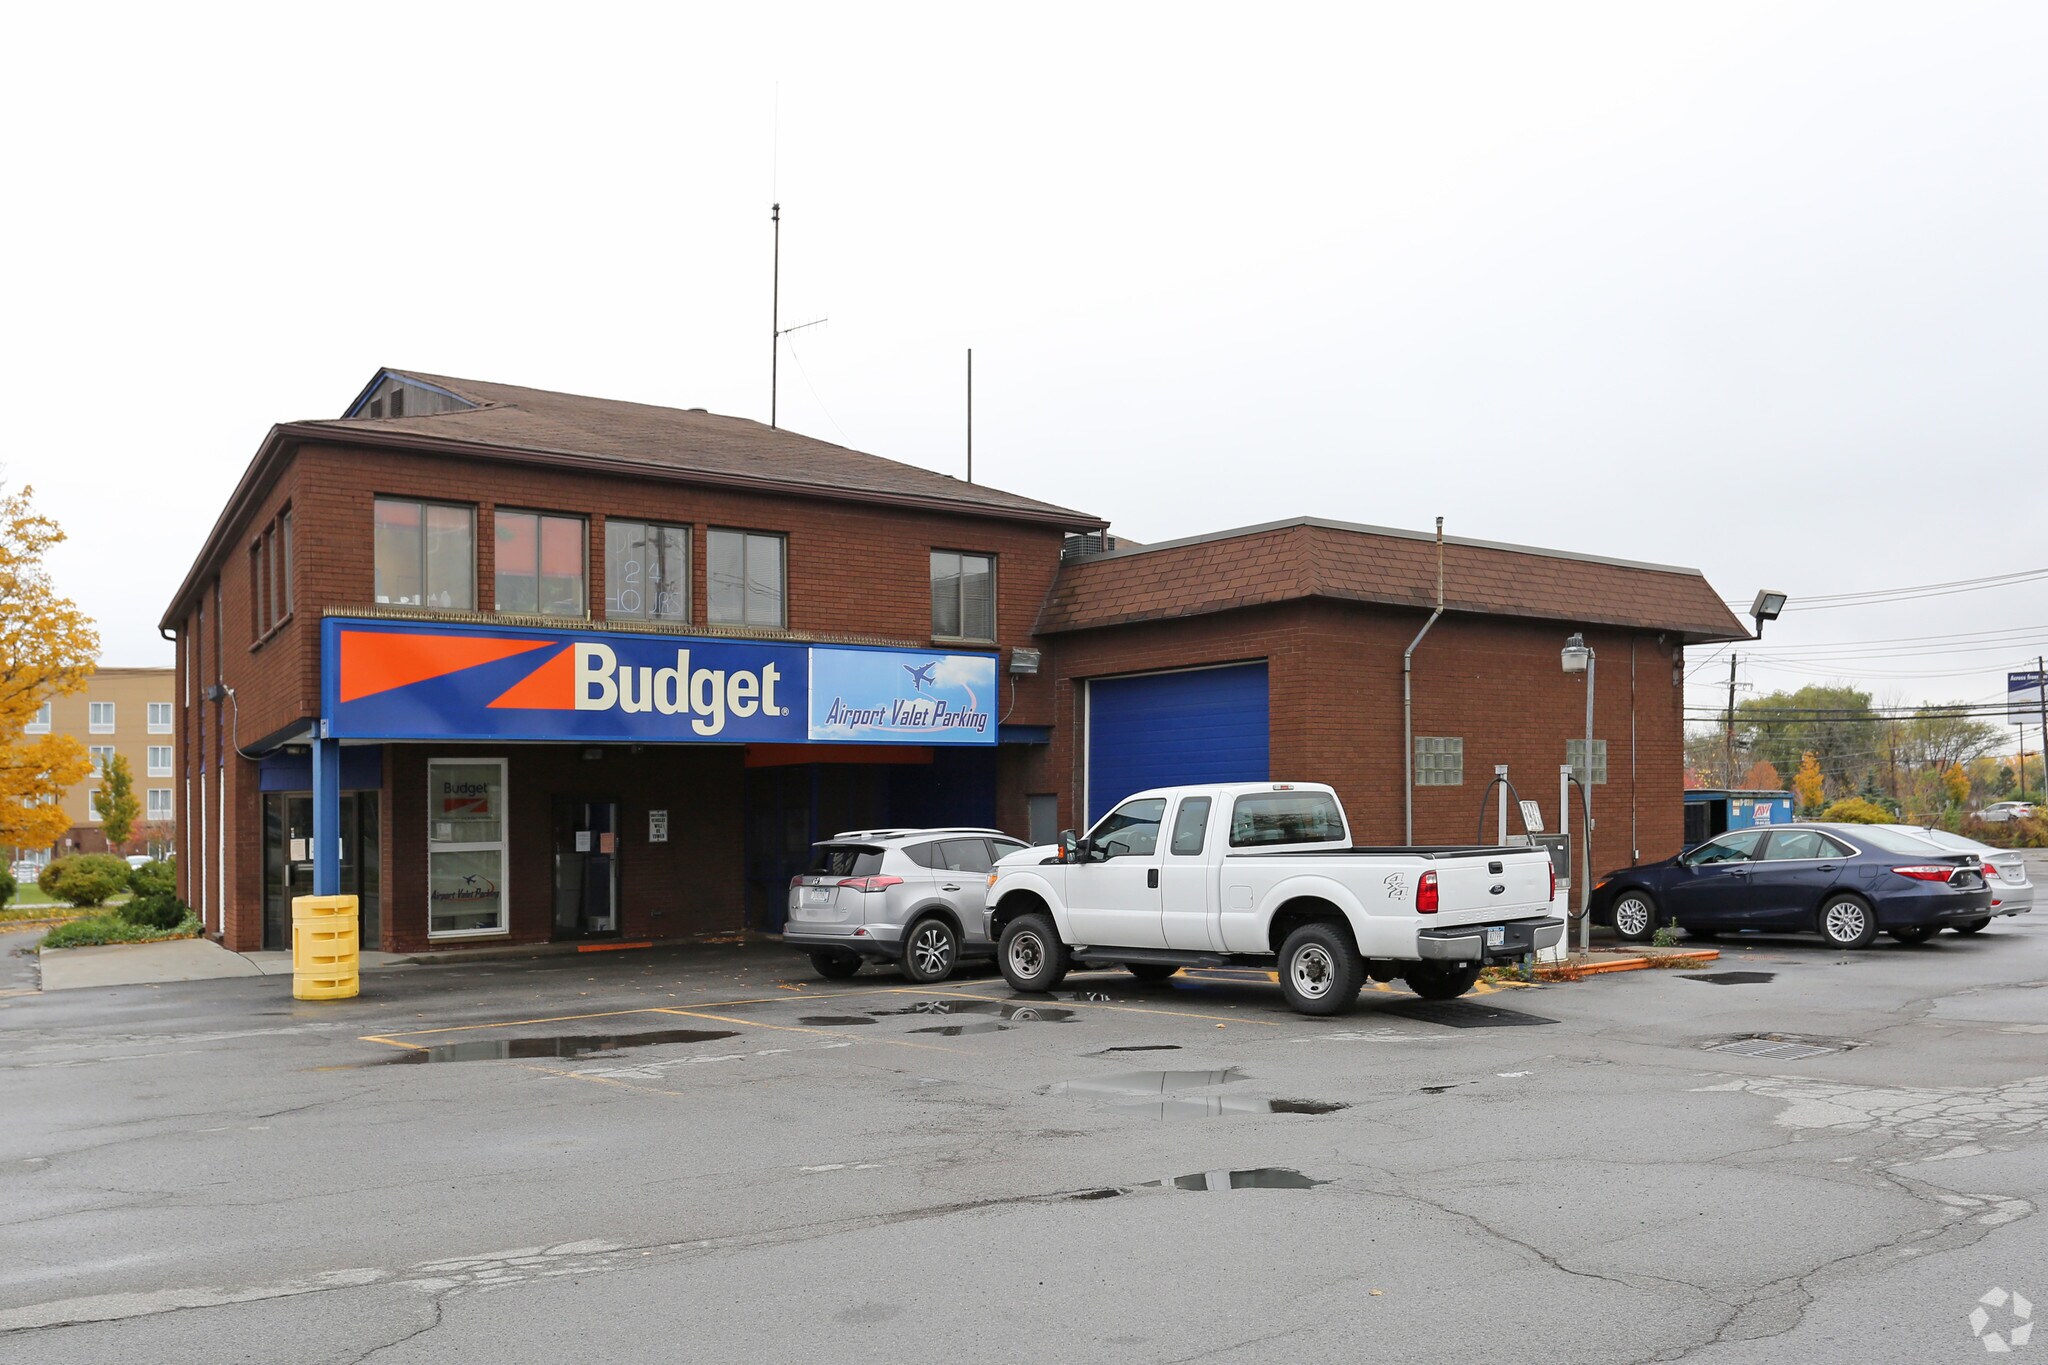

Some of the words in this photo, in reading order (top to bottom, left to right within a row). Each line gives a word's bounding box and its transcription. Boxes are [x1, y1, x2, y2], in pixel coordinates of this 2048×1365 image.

[575, 642, 781, 736] Budget
[825, 697, 886, 730] Airport
[891, 699, 929, 726] Valet
[931, 700, 988, 733] Parking
[443, 782, 488, 797] Budget
